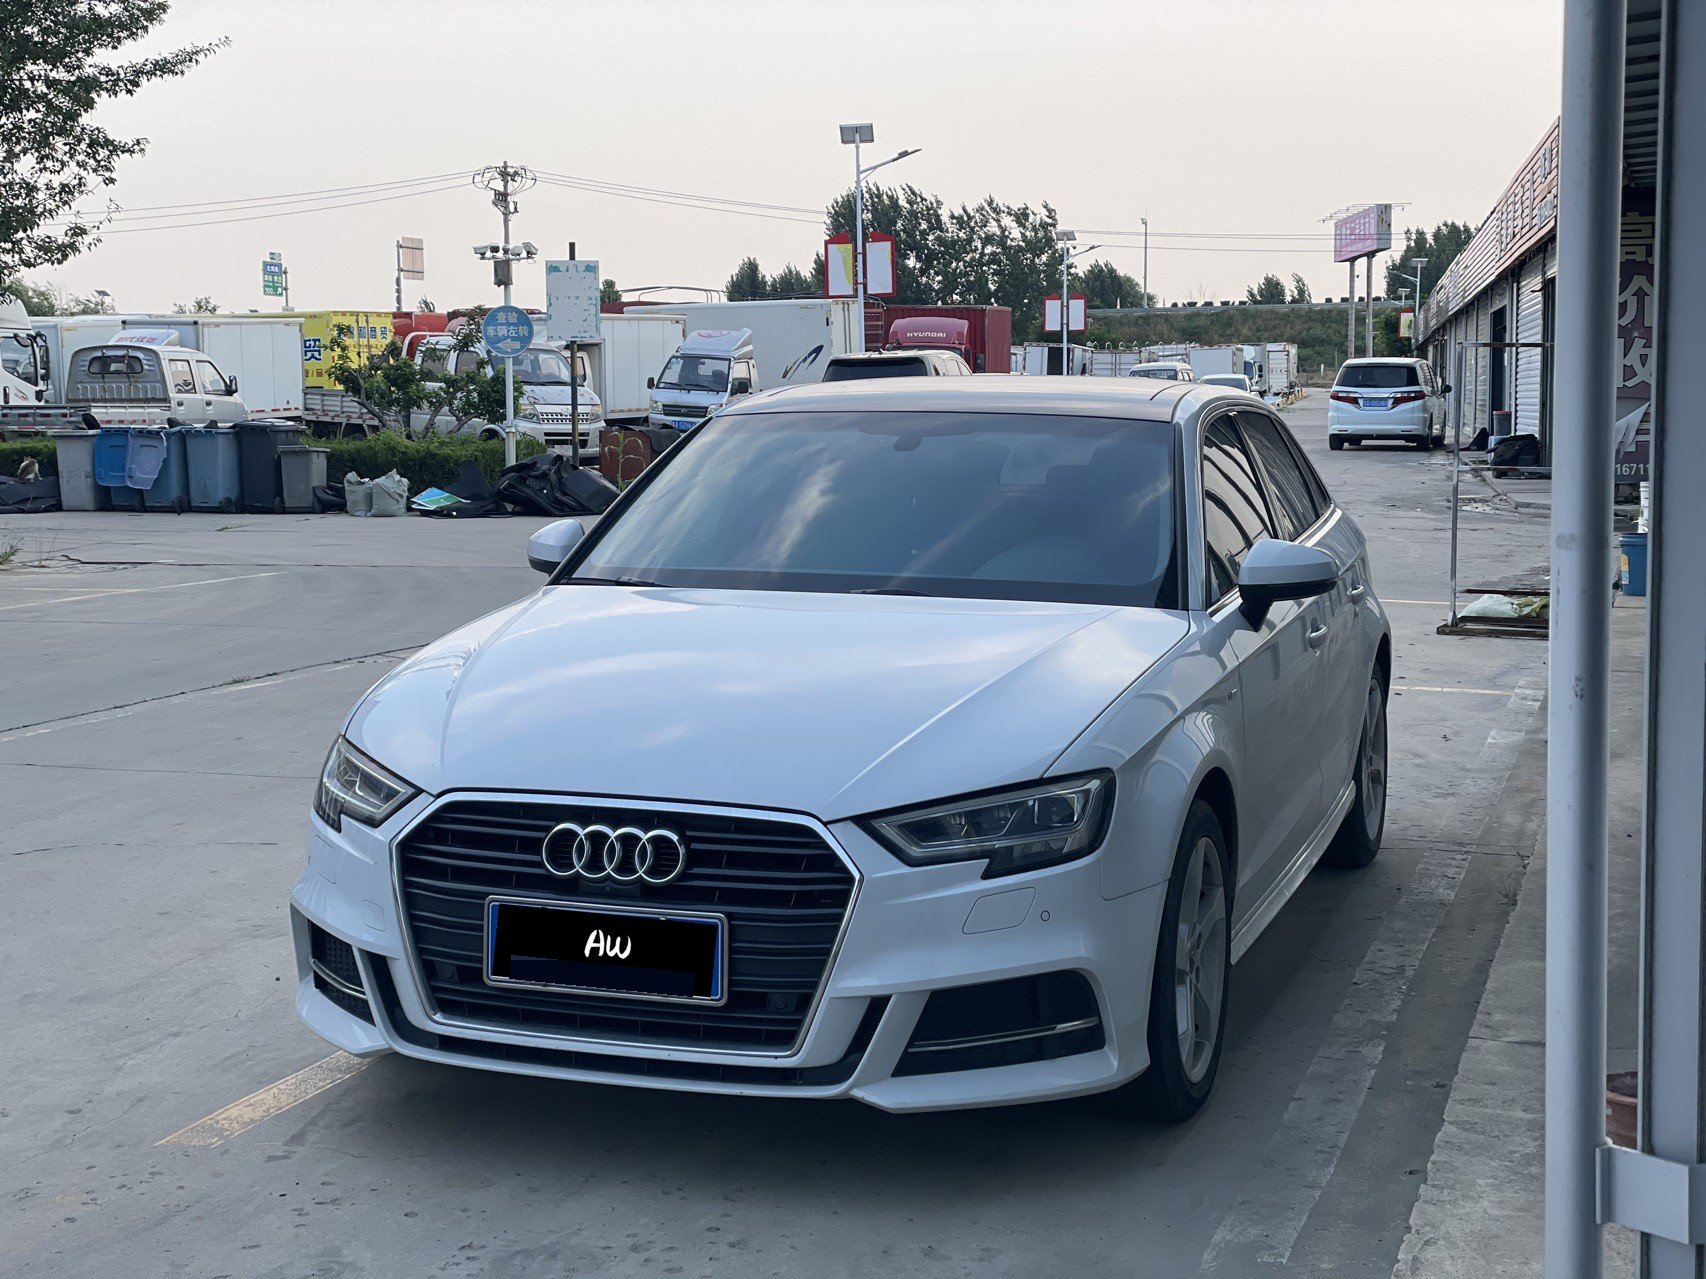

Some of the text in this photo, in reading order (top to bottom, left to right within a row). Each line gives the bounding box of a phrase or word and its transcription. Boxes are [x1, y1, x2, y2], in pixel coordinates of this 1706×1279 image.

[496, 311, 518, 323] 查验
[486, 325, 529, 338] 车辆左转
